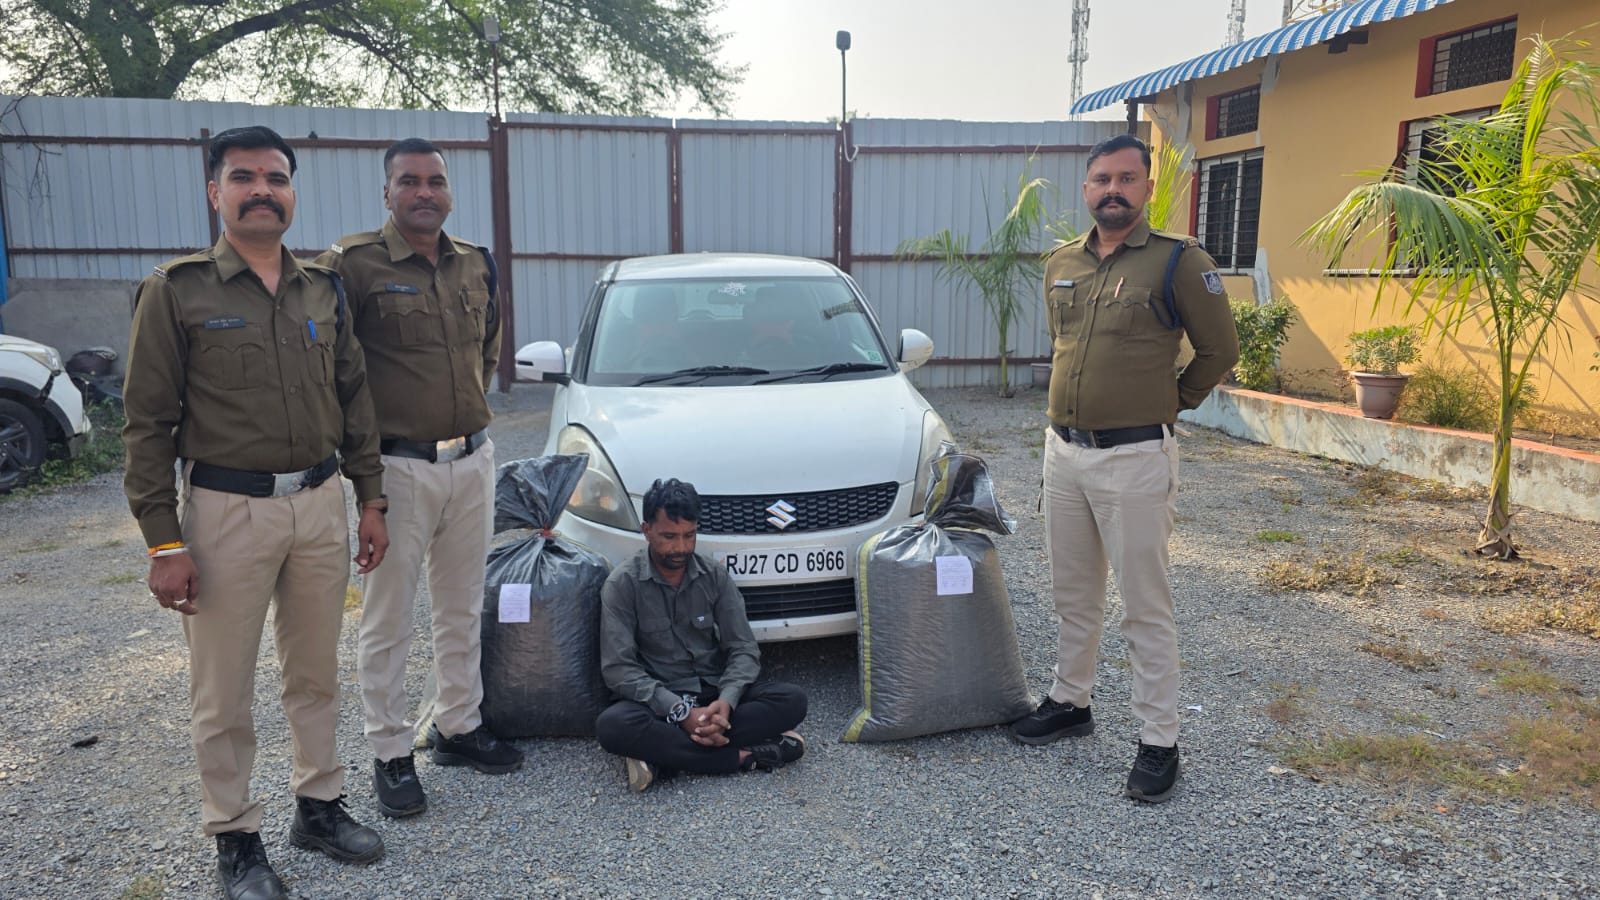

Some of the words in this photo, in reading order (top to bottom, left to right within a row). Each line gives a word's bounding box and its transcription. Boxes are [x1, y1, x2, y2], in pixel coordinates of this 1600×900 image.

[726, 555, 768, 575] RJ27
[774, 553, 799, 573] CD
[806, 550, 844, 572] 6966
